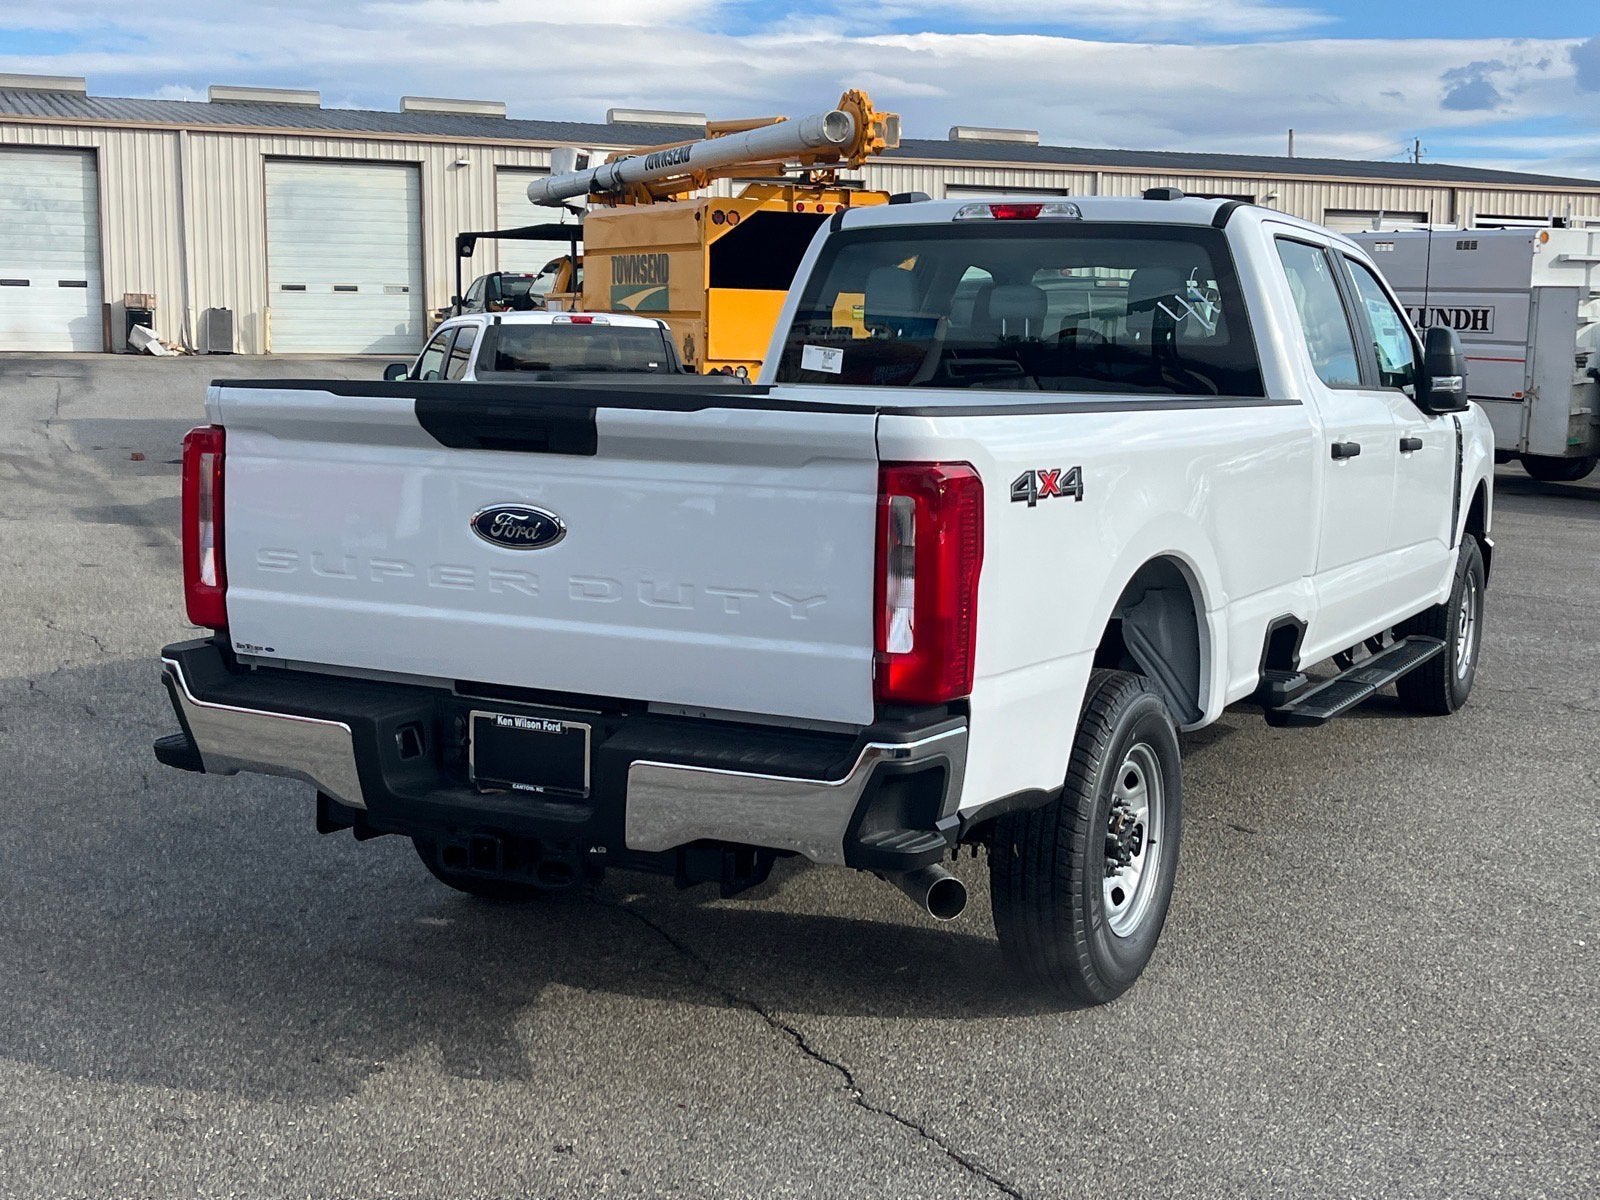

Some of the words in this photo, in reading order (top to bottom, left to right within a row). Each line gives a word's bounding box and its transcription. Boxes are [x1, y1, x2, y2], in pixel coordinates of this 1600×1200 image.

[645, 145, 693, 171] TOWNSEND
[611, 254, 669, 285] TOWNSEND
[490, 512, 541, 540] Ford
[256, 549, 539, 596] SUPER
[569, 575, 827, 620] DUTY
[497, 715, 513, 726] Ken
[515, 717, 541, 729] Wilson
[543, 720, 561, 731] Ford
